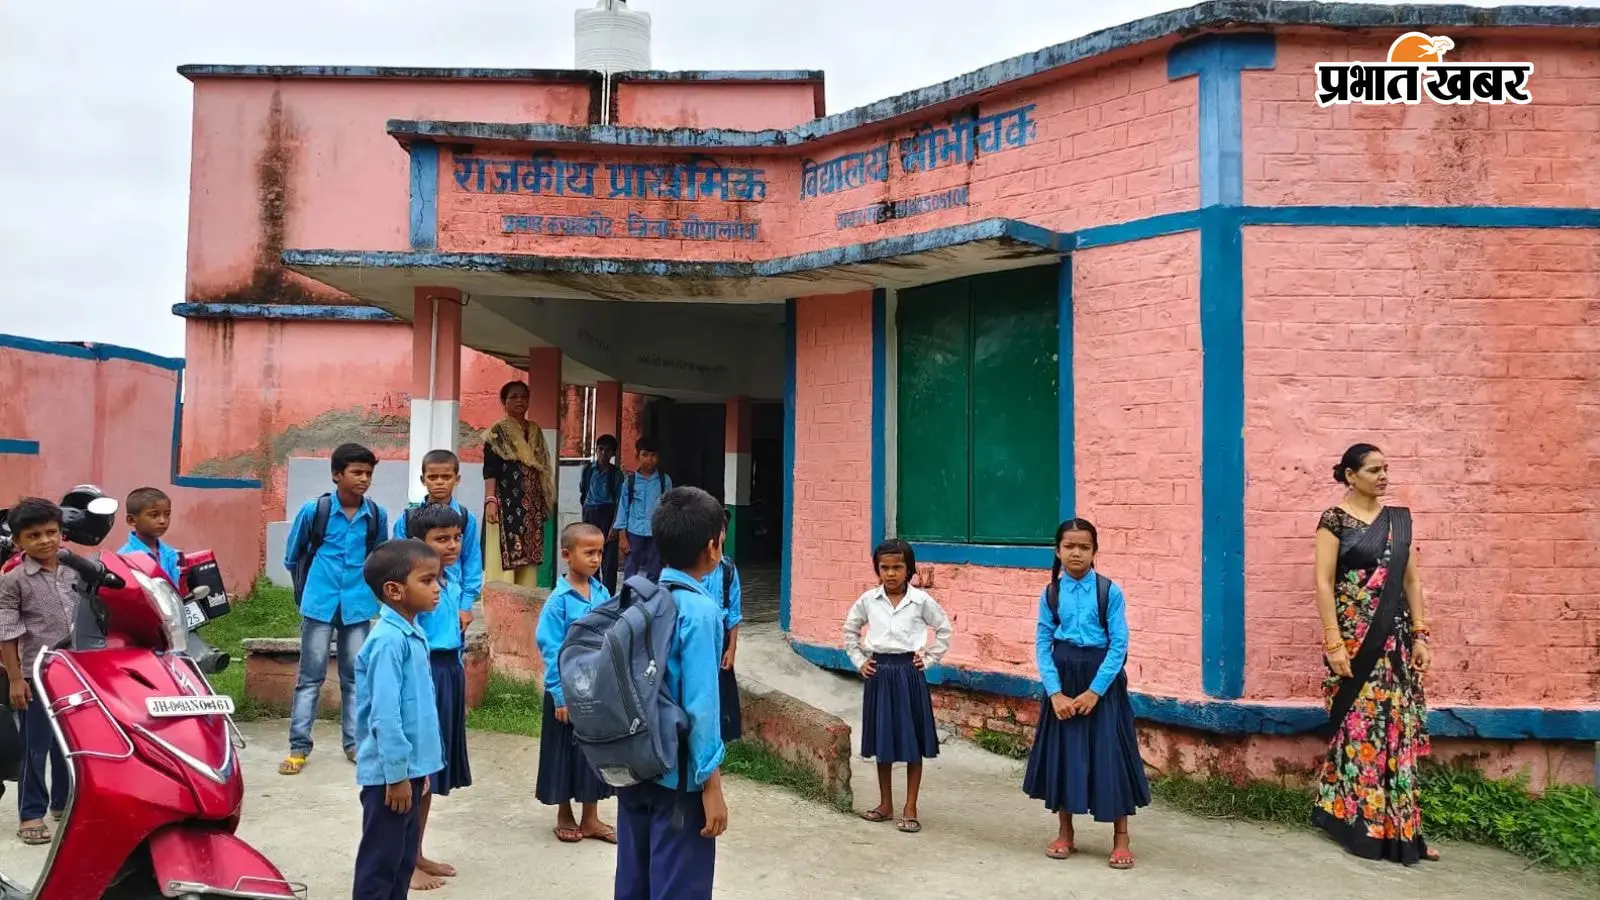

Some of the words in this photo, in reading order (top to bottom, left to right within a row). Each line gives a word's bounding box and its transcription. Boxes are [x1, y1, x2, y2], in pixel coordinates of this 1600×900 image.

[453, 153, 599, 197] राजकीय
[605, 154, 767, 201] प्राथमिक
[800, 145, 890, 200] विद्यालय
